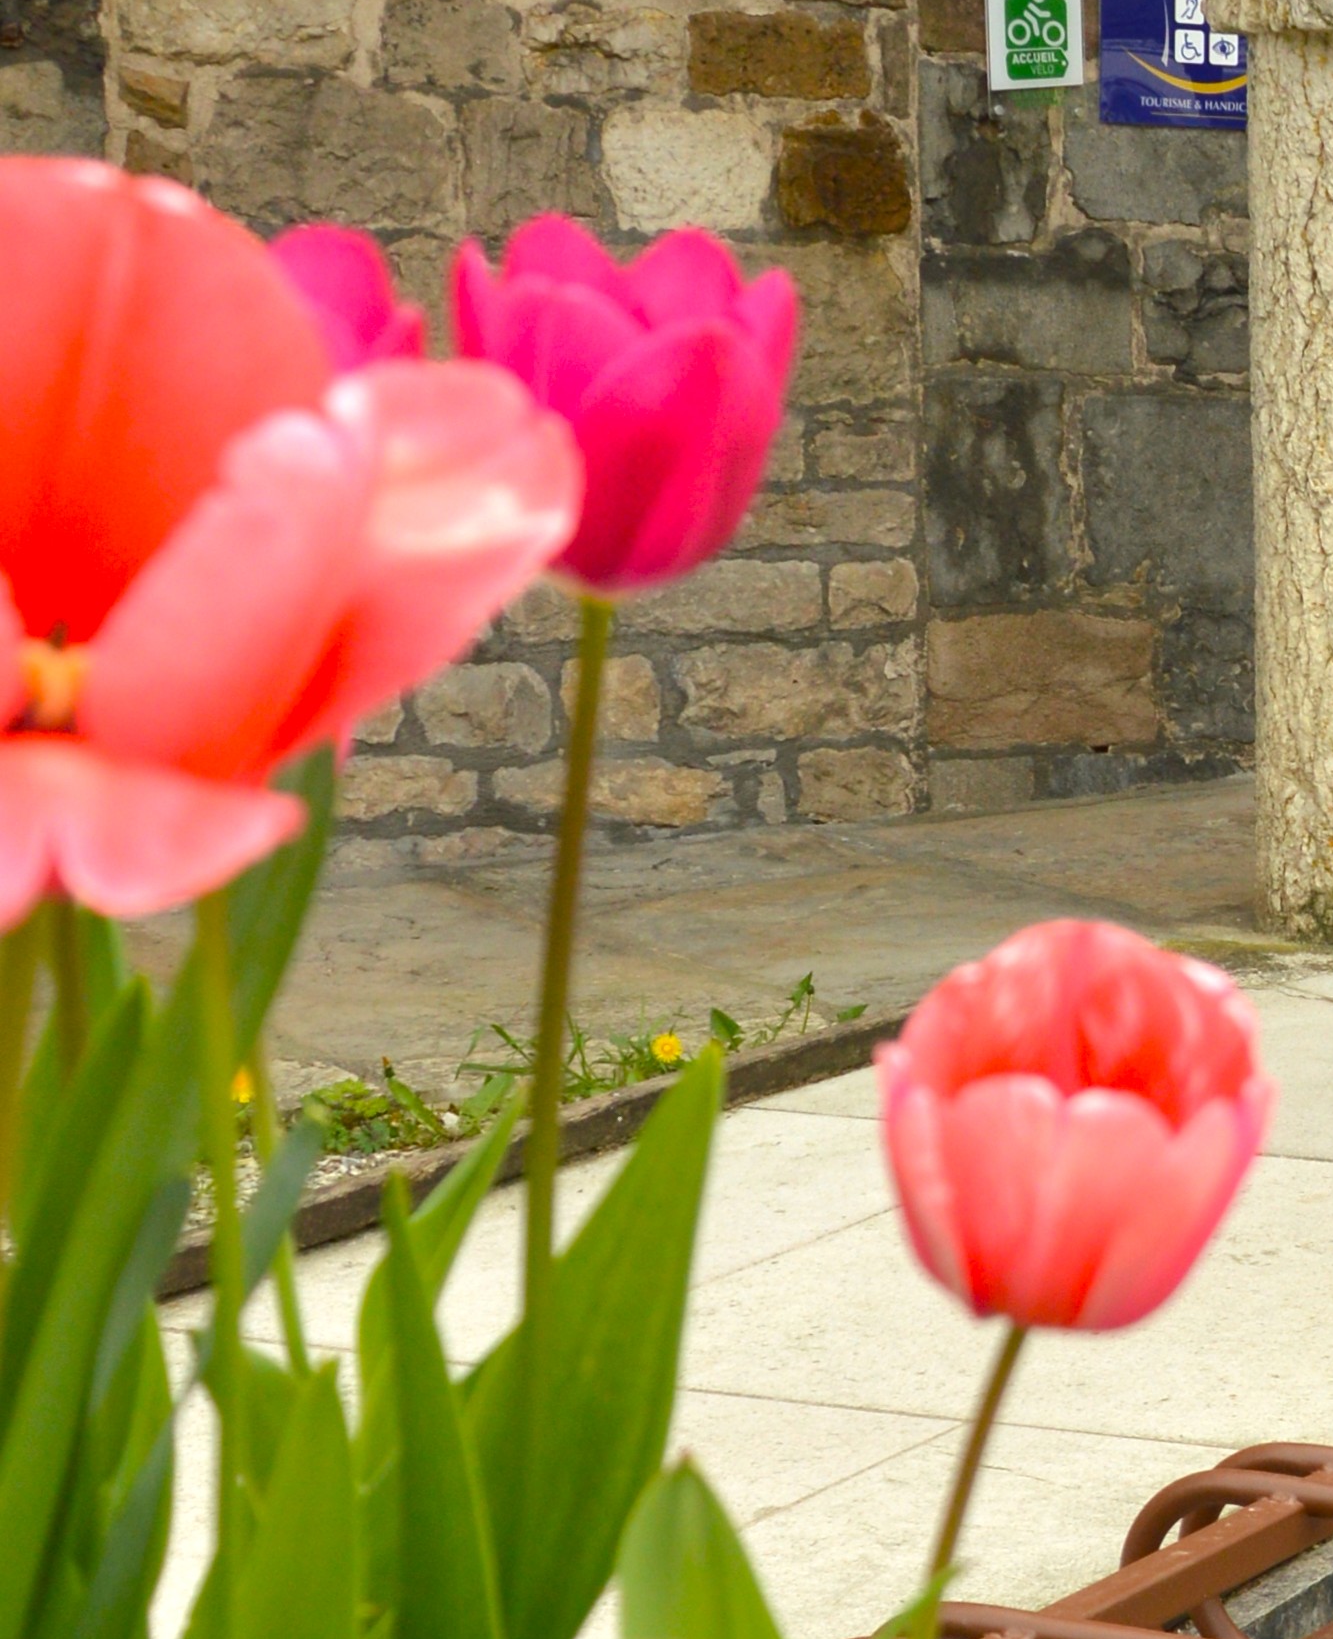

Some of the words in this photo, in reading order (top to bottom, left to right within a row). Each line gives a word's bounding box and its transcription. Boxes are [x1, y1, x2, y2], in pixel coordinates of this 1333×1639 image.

[1011, 51, 1059, 65] ACCUEIL
[1140, 95, 1192, 110] TOURISME
[1193, 100, 1202, 110] &
[1204, 100, 1247, 113] HANDIC
